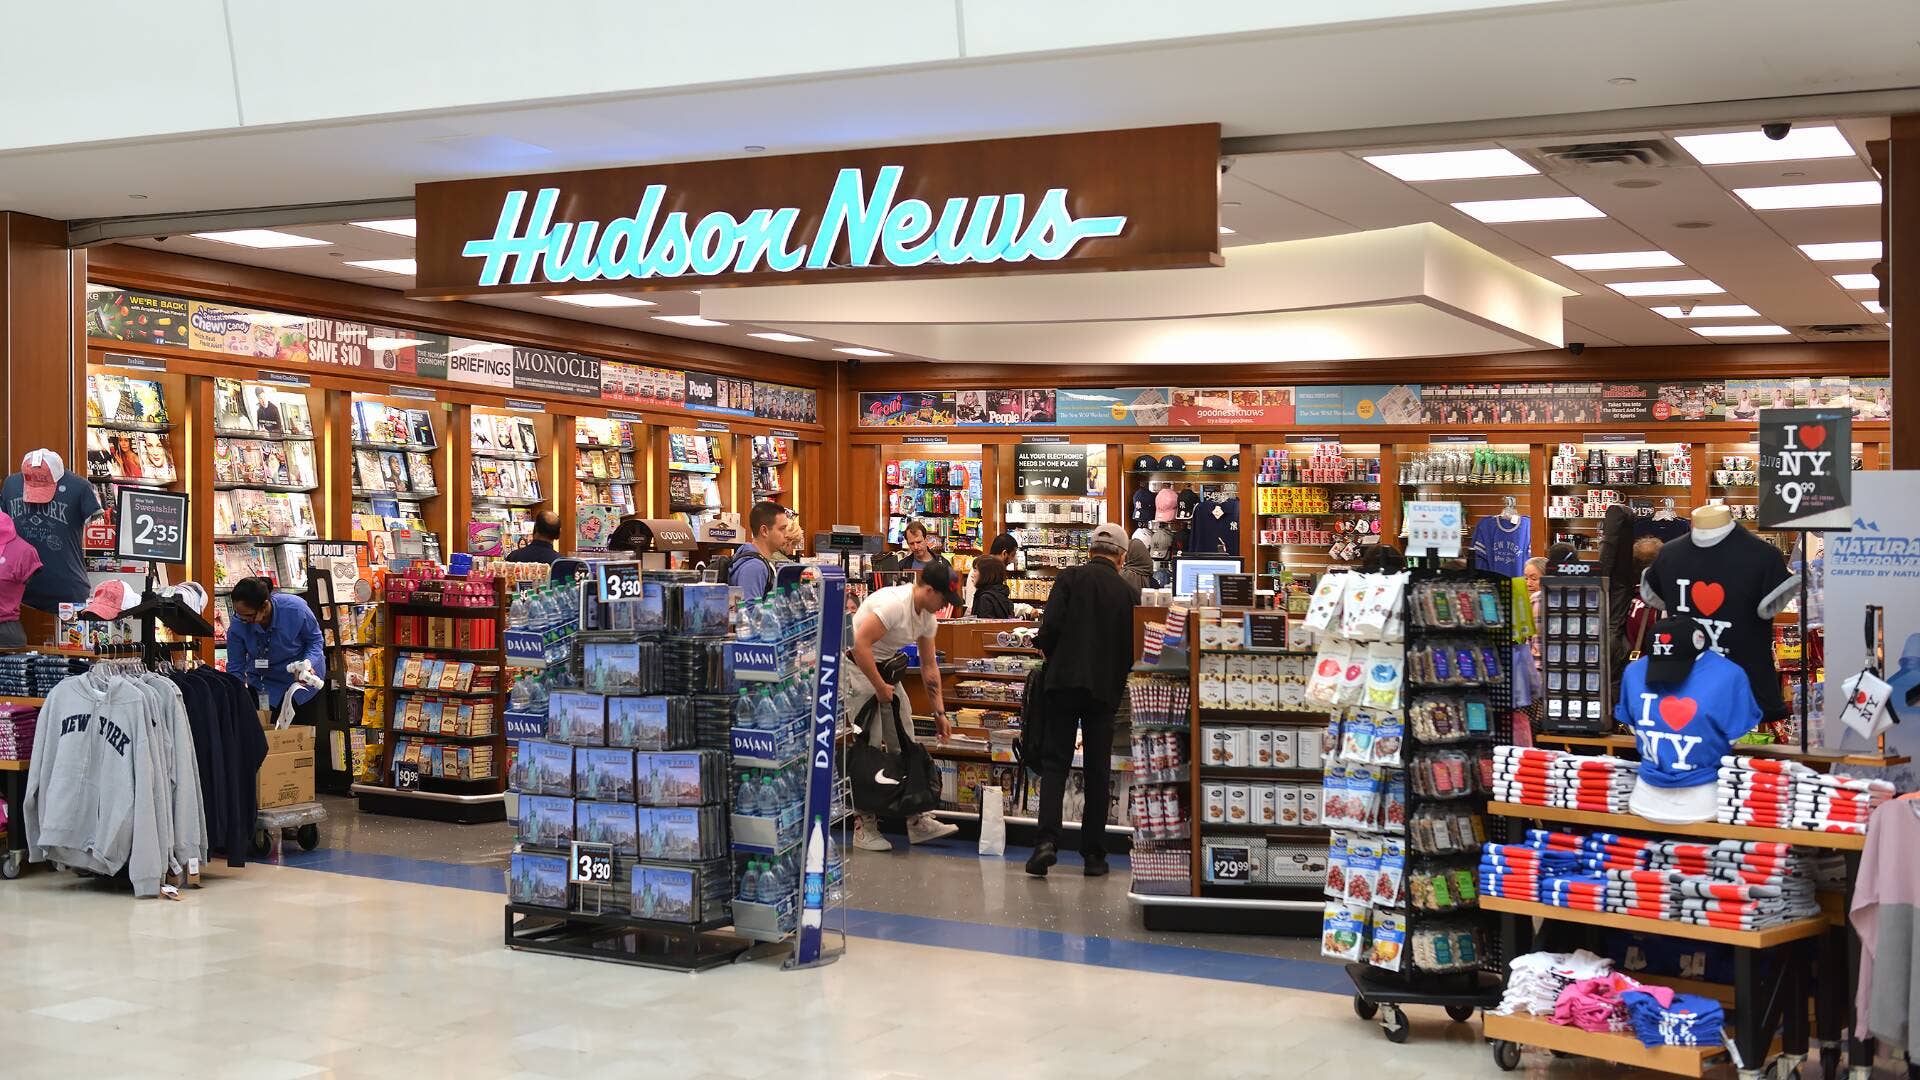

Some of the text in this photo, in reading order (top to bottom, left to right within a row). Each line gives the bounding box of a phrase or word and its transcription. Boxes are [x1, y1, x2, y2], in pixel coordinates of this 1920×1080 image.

[462, 165, 1126, 287] Hudson News
[130, 296, 187, 311] WE'RE BACK!
[192, 314, 227, 335] Chewy
[308, 318, 368, 346] BUY BOTH
[309, 340, 362, 367] SAVE $10
[417, 357, 446, 367] ECONOMY
[450, 355, 511, 377] BRIEFINGS
[514, 350, 600, 380] MONOCLE
[688, 380, 713, 400] People
[870, 393, 902, 418] Trolli
[988, 410, 1020, 426] People
[1783, 425, 1798, 449] I
[1778, 451, 1831, 476] NY
[134, 503, 177, 514] Sweatshirt
[134, 514, 155, 545] 2
[660, 531, 690, 541] GODIVA
[309, 543, 341, 555] BUY BOTH
[1557, 563, 1590, 575] zippo
[1831, 569, 1875, 577] CRAFTED
[1676, 579, 1690, 612] I
[507, 638, 542, 653] DASANI
[1654, 633, 1660, 644] I
[735, 650, 774, 665] DASANI
[1653, 644, 1674, 655] NY
[814, 654, 836, 769] DASANI
[1638, 692, 1658, 726] I
[60, 713, 131, 757] NEW YORK
[507, 719, 541, 735] DASANI
[735, 736, 773, 752] DASANI
[1637, 729, 1703, 771] NY
